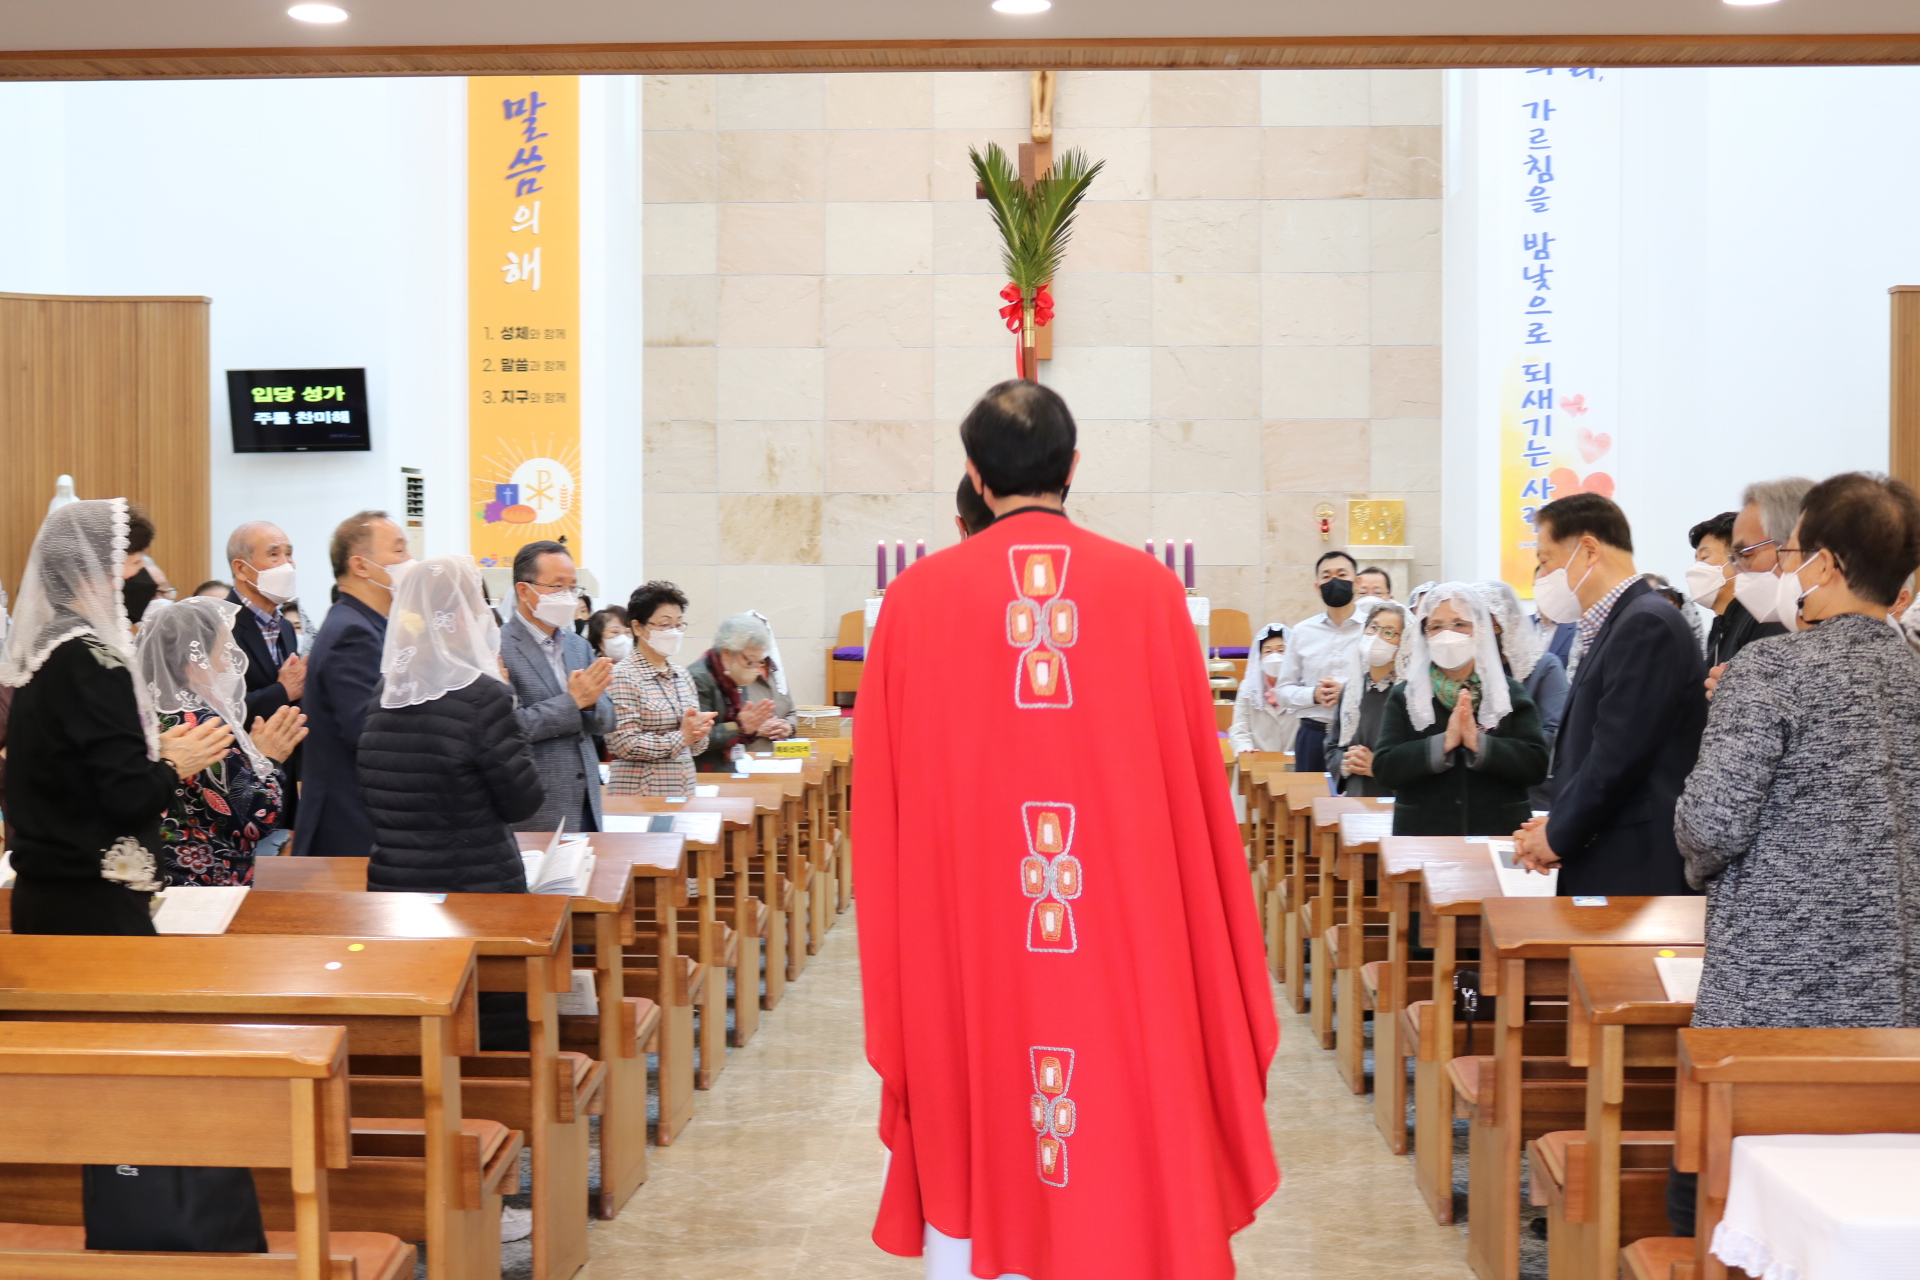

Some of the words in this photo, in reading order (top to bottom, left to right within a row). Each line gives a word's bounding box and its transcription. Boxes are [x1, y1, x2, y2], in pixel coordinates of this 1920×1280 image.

[502, 91, 549, 234] 말씀의
[1522, 99, 1556, 213] 가르침을
[501, 247, 541, 291] 해
[1522, 232, 1556, 344] 밤낮으로
[483, 326, 494, 340] 1.
[501, 326, 540, 340] 성체와
[544, 328, 566, 340] 함께
[482, 358, 496, 372] 2.
[501, 358, 541, 372] 말씀과
[544, 360, 566, 372] 함께
[251, 386, 296, 403] 입당
[301, 386, 346, 402] 성가
[482, 390, 496, 404] 3.
[501, 390, 541, 404] 지구와
[544, 392, 566, 404] 함께
[295, 410, 350, 425] 찬미해
[1521, 362, 1553, 467] 되새기는
